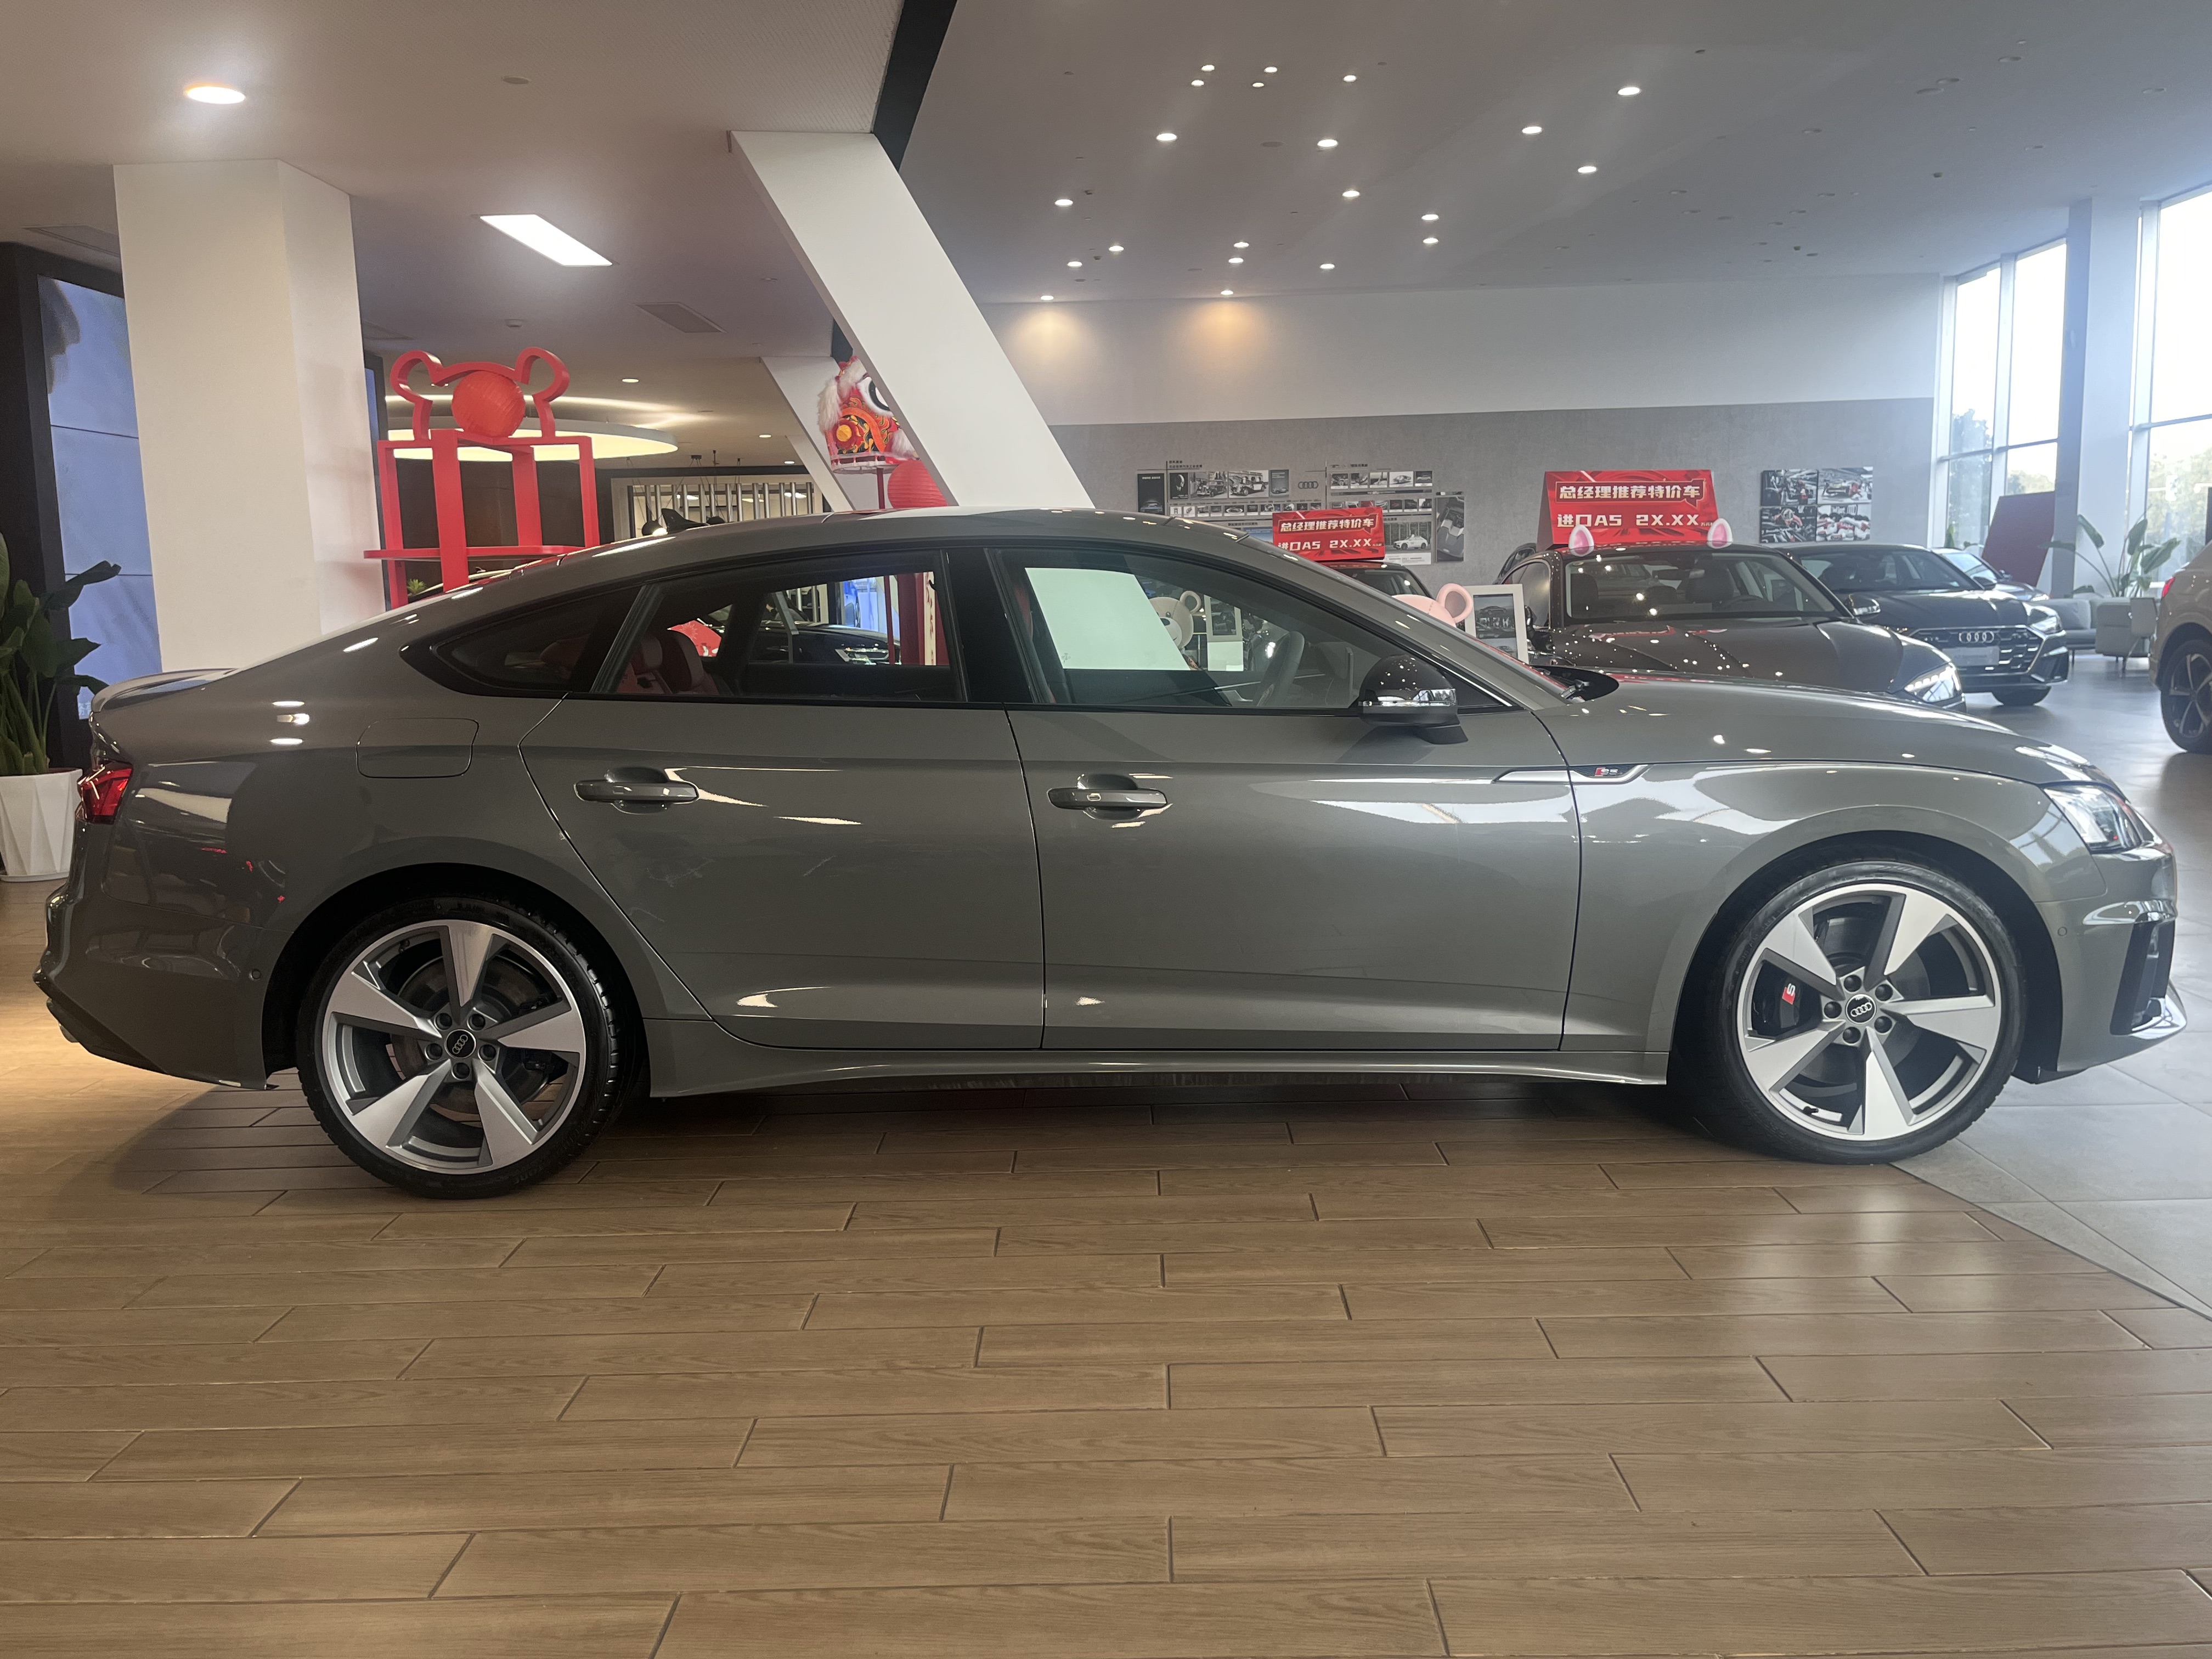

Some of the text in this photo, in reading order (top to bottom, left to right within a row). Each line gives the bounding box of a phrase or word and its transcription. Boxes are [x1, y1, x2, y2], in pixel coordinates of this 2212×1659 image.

[1559, 485, 1701, 499] 总经理推荐特价车
[1280, 518, 1374, 532] 总经理推荐特价车
[1557, 514, 1622, 527] 进口A5
[1635, 514, 1700, 527] 2X.XX
[1278, 538, 1372, 551] 进口A5 2X.XX
[1786, 983, 1796, 996] S
